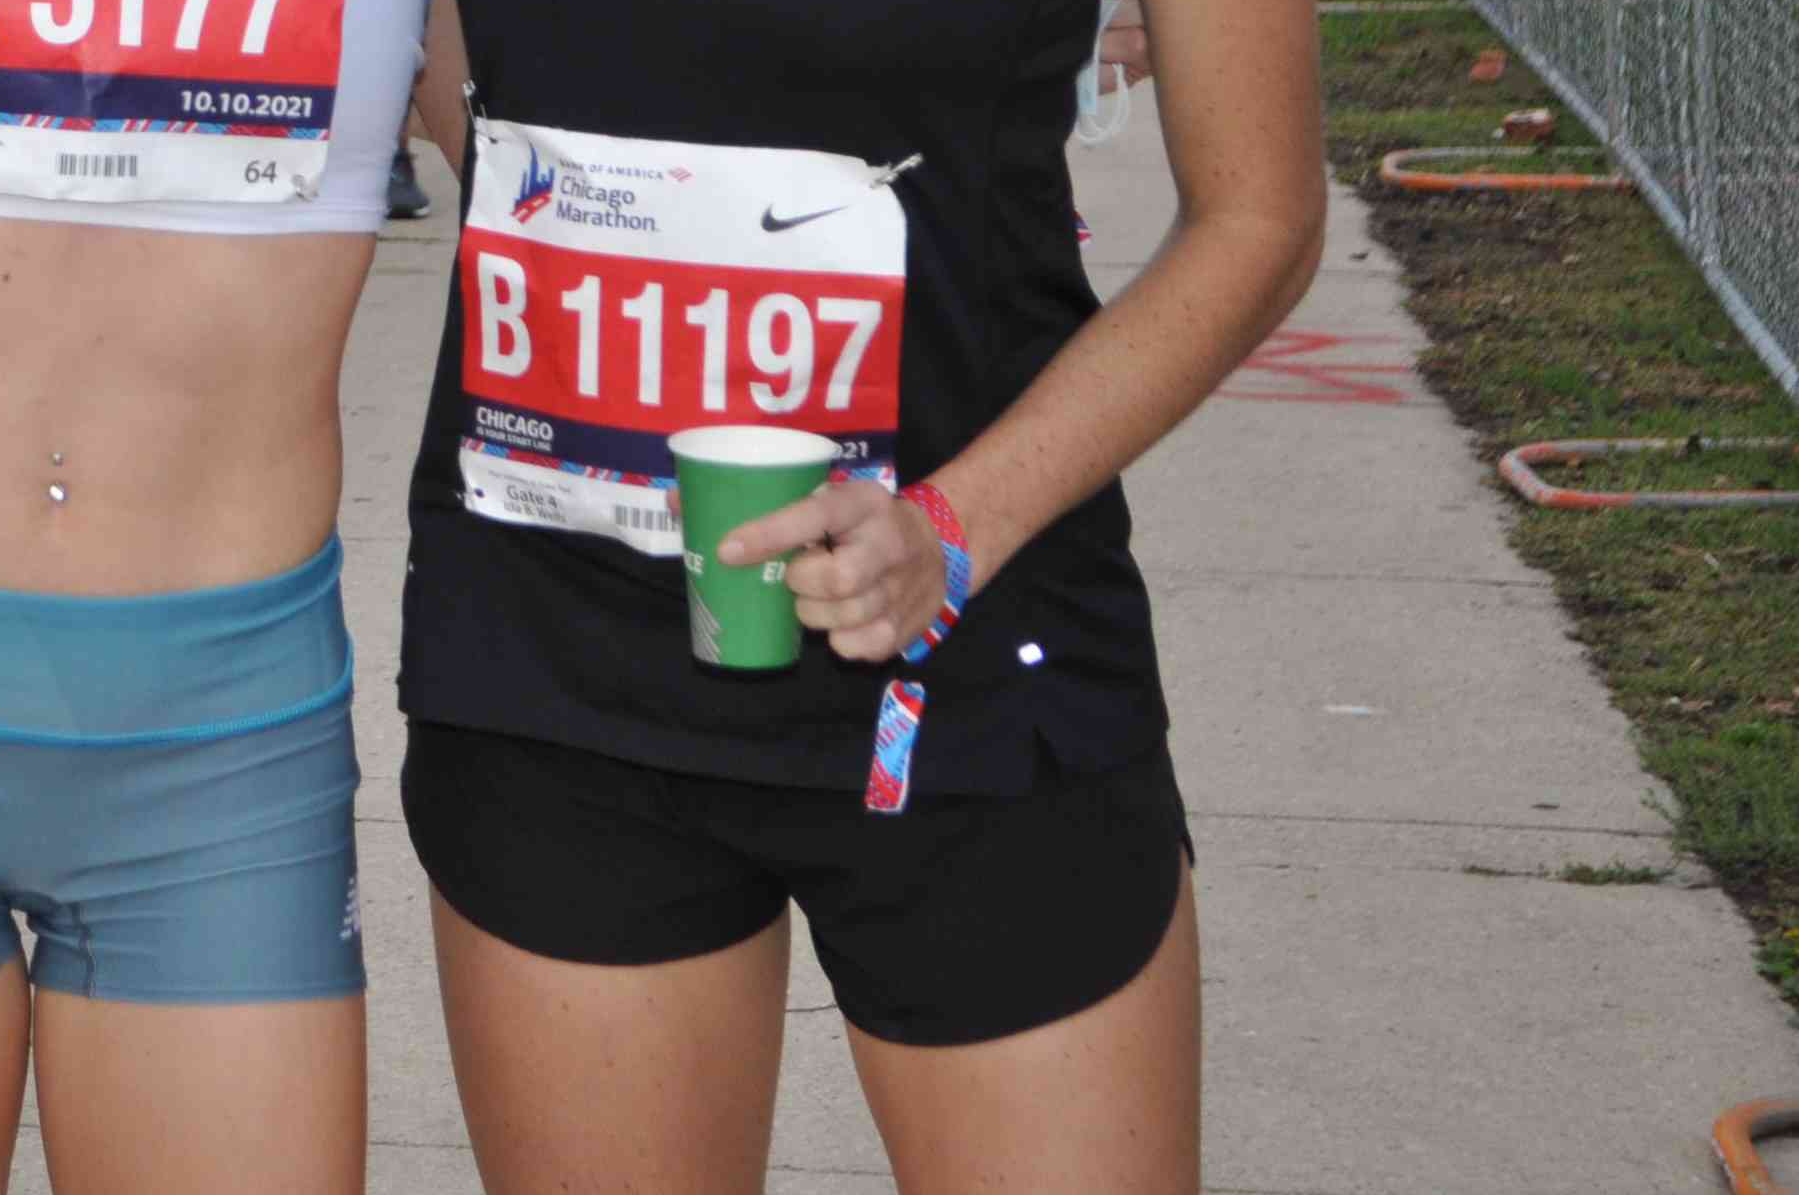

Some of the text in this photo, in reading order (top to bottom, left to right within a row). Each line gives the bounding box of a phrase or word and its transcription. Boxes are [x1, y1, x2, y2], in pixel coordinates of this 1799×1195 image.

[181, 89, 313, 119] 10.10.2021
[244, 160, 277, 184] 64
[560, 174, 636, 209] Chicago
[477, 251, 883, 415] B 11197
[475, 405, 555, 441] CHICAGO
[506, 484, 558, 509] Gate 4
